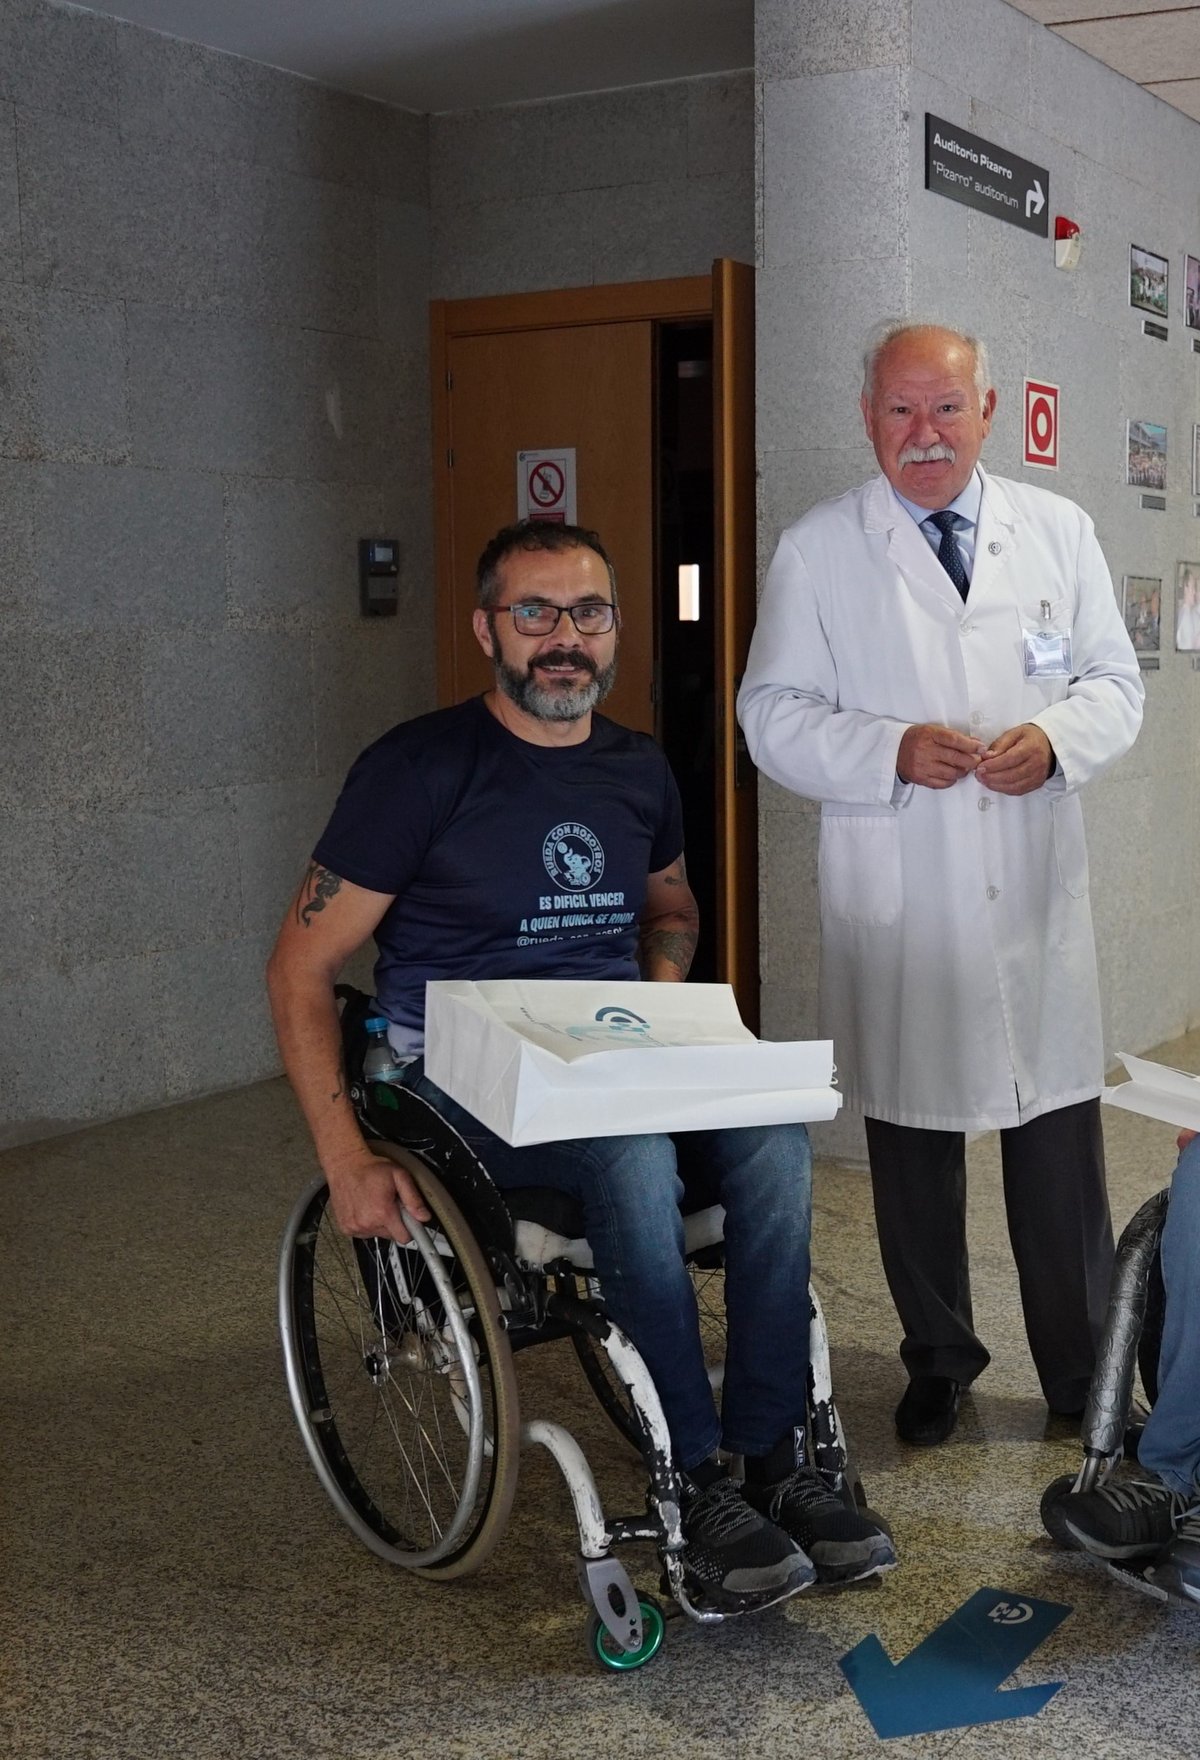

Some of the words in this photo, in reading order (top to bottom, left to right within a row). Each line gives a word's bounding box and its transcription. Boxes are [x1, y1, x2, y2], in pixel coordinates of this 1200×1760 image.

[933, 133, 979, 163] Auditorio
[980, 154, 1013, 180] Pizarro
[974, 182, 1019, 209] auditorium
[551, 825, 571, 841] CON
[545, 841, 559, 877] RUEDA
[572, 825, 603, 874] NOSOTROS
[539, 896, 552, 910] ES
[553, 894, 588, 909] DIFICIL
[589, 892, 624, 907] VENCER
[520, 919, 529, 932] A
[530, 916, 560, 932] QUIEN
[561, 913, 595, 927] NUNCA
[595, 913, 610, 925] SE
[608, 912, 635, 924] RINDE
